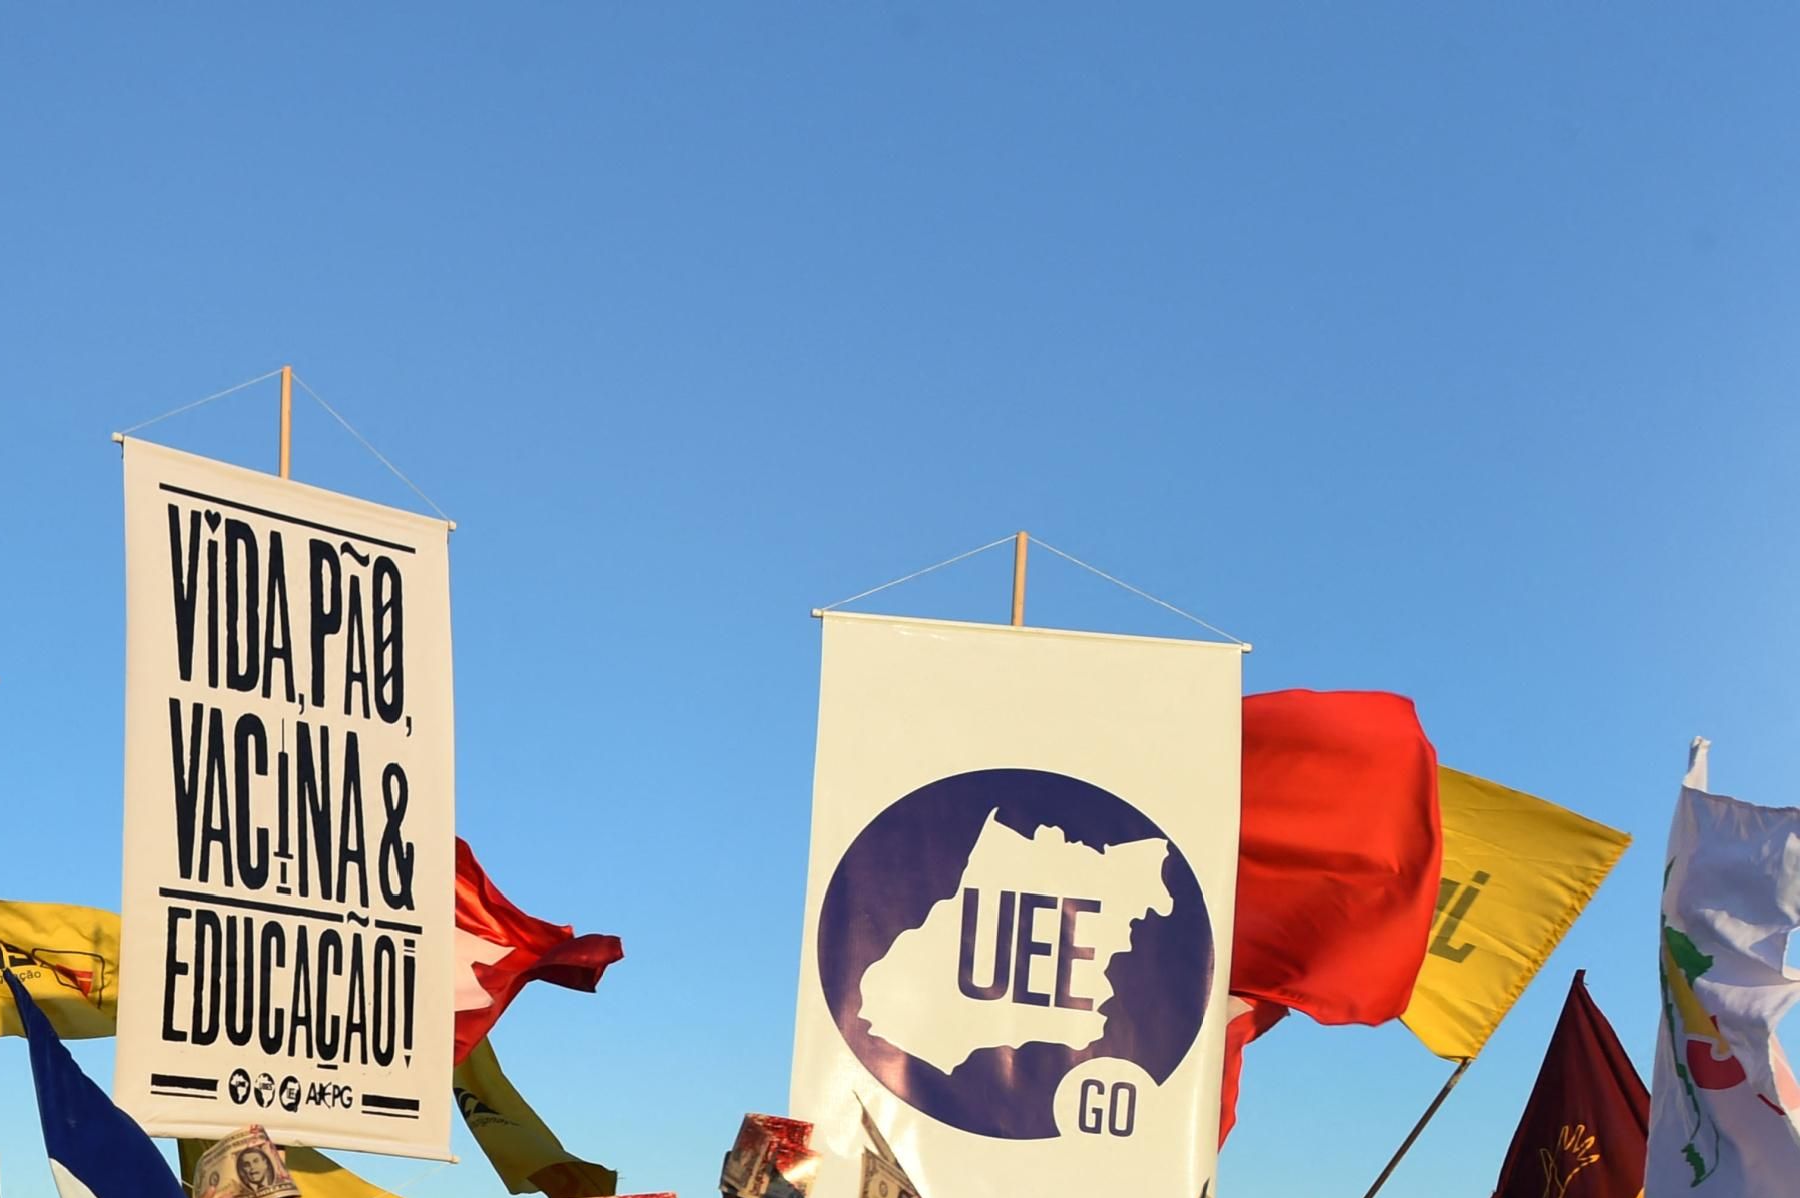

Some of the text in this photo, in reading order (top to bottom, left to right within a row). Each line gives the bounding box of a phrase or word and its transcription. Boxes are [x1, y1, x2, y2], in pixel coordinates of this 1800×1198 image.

[308, 538, 413, 738] PÃO,
[168, 697, 416, 911] VACINA &
[160, 906, 416, 1070] EDUCAÇÃO!
[957, 887, 1102, 1012] UEE
[1078, 1078, 1137, 1138] GO
